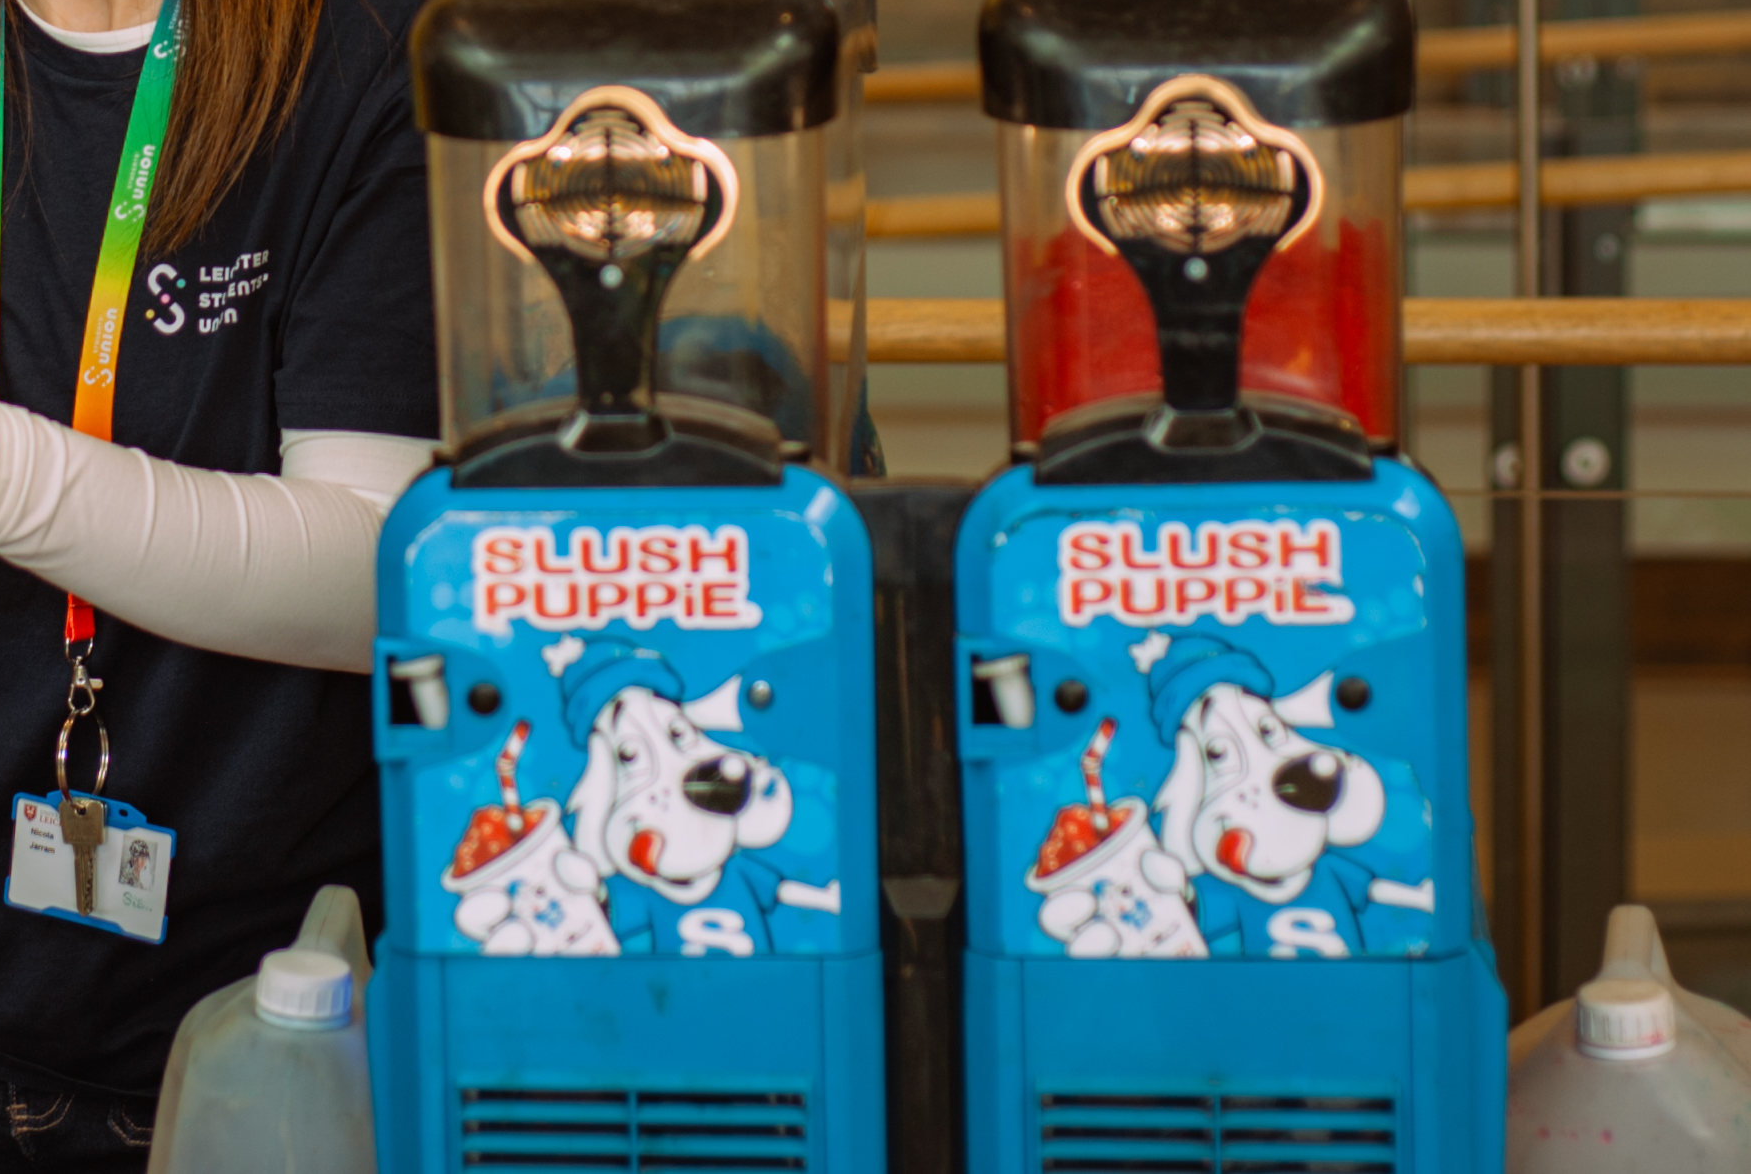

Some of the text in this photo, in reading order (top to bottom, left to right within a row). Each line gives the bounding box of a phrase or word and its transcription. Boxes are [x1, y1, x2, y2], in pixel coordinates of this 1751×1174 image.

[132, 144, 156, 200] UNION
[98, 308, 118, 365] UNION
[481, 534, 741, 576] SLUSH
[1065, 528, 1331, 571] SLUSH
